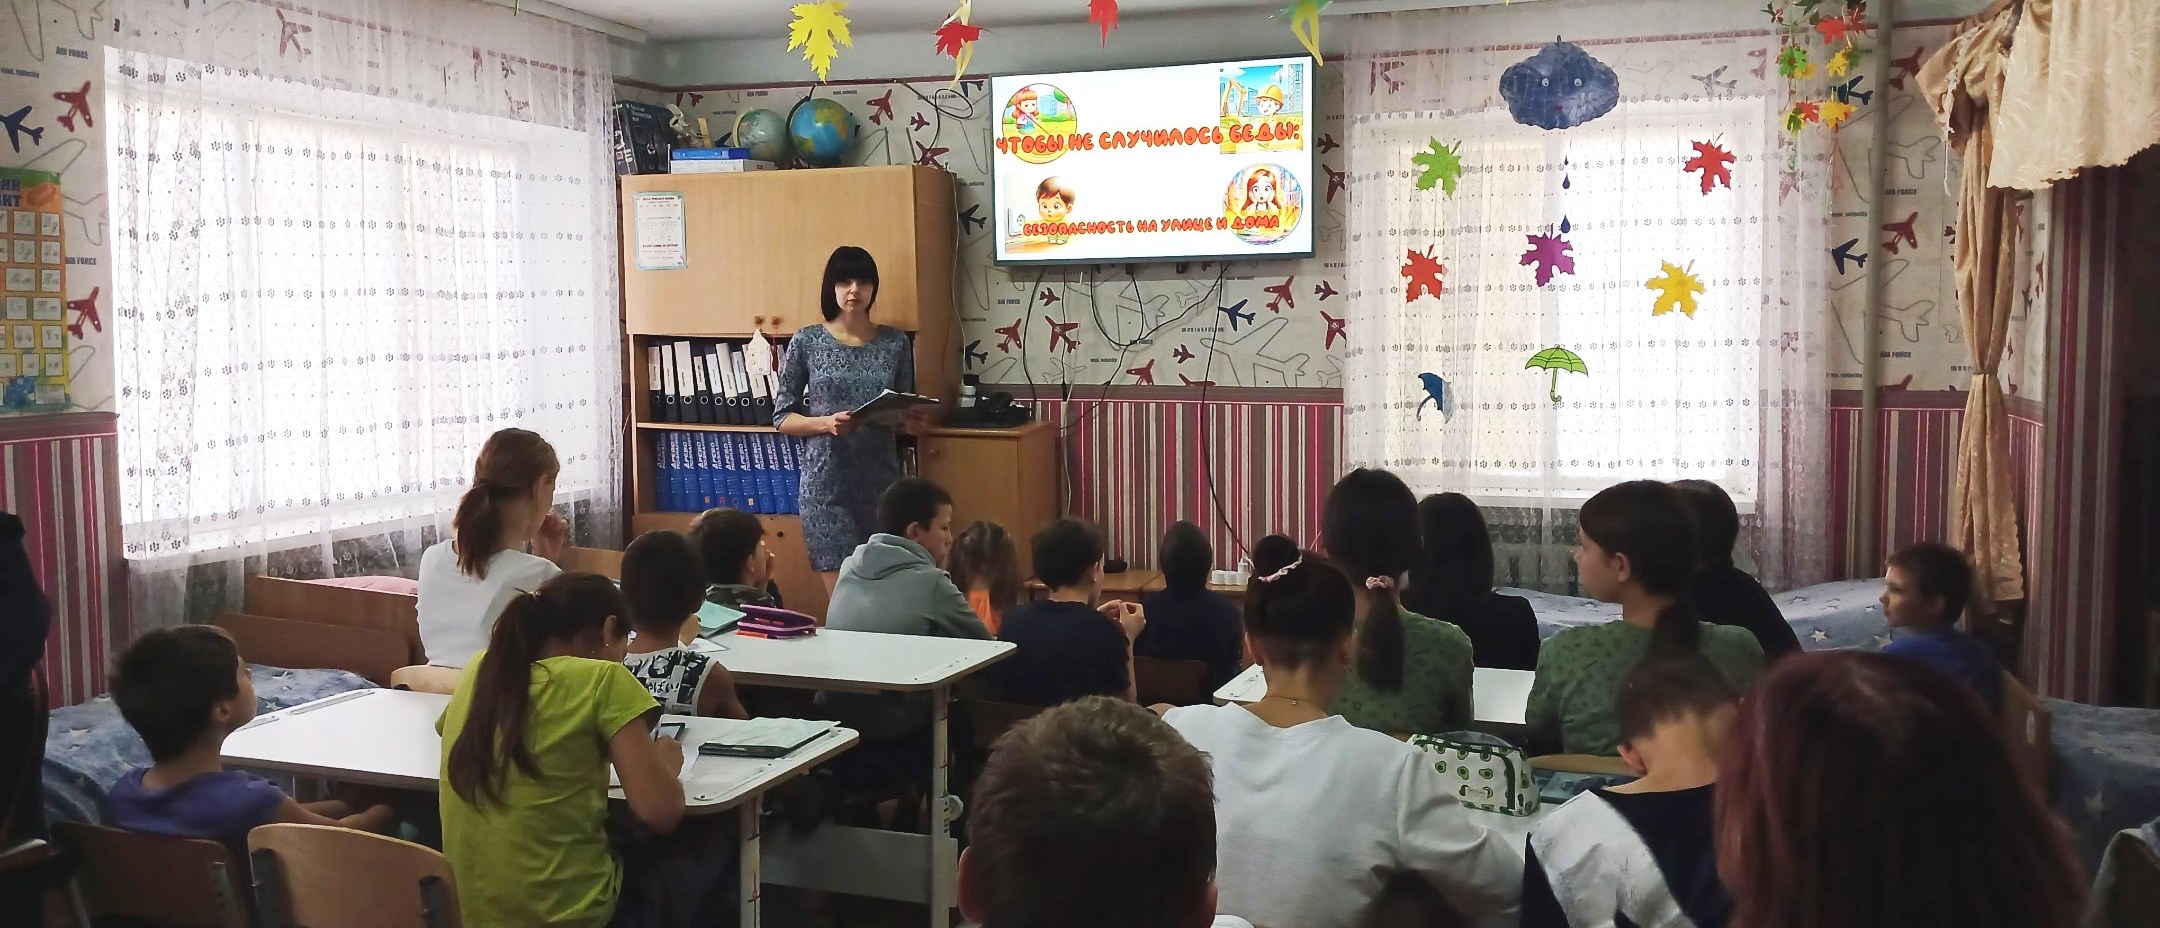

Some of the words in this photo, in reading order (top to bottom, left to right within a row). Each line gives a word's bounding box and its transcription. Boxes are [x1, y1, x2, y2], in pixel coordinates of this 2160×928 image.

[996, 134, 1064, 155] ЧТОБЫ
[1068, 132, 1094, 151] НЕ
[1099, 126, 1223, 150] СЛУЧИЛОСЬ
[1229, 122, 1300, 143] БЕДЫ:
[1023, 221, 1135, 236] БЕЗОПАСНОСТЬ
[1138, 220, 1157, 233] НА
[1161, 218, 1213, 233] УЛИЦЕ
[1216, 217, 1228, 230] И
[1231, 215, 1280, 230] ДОМА
